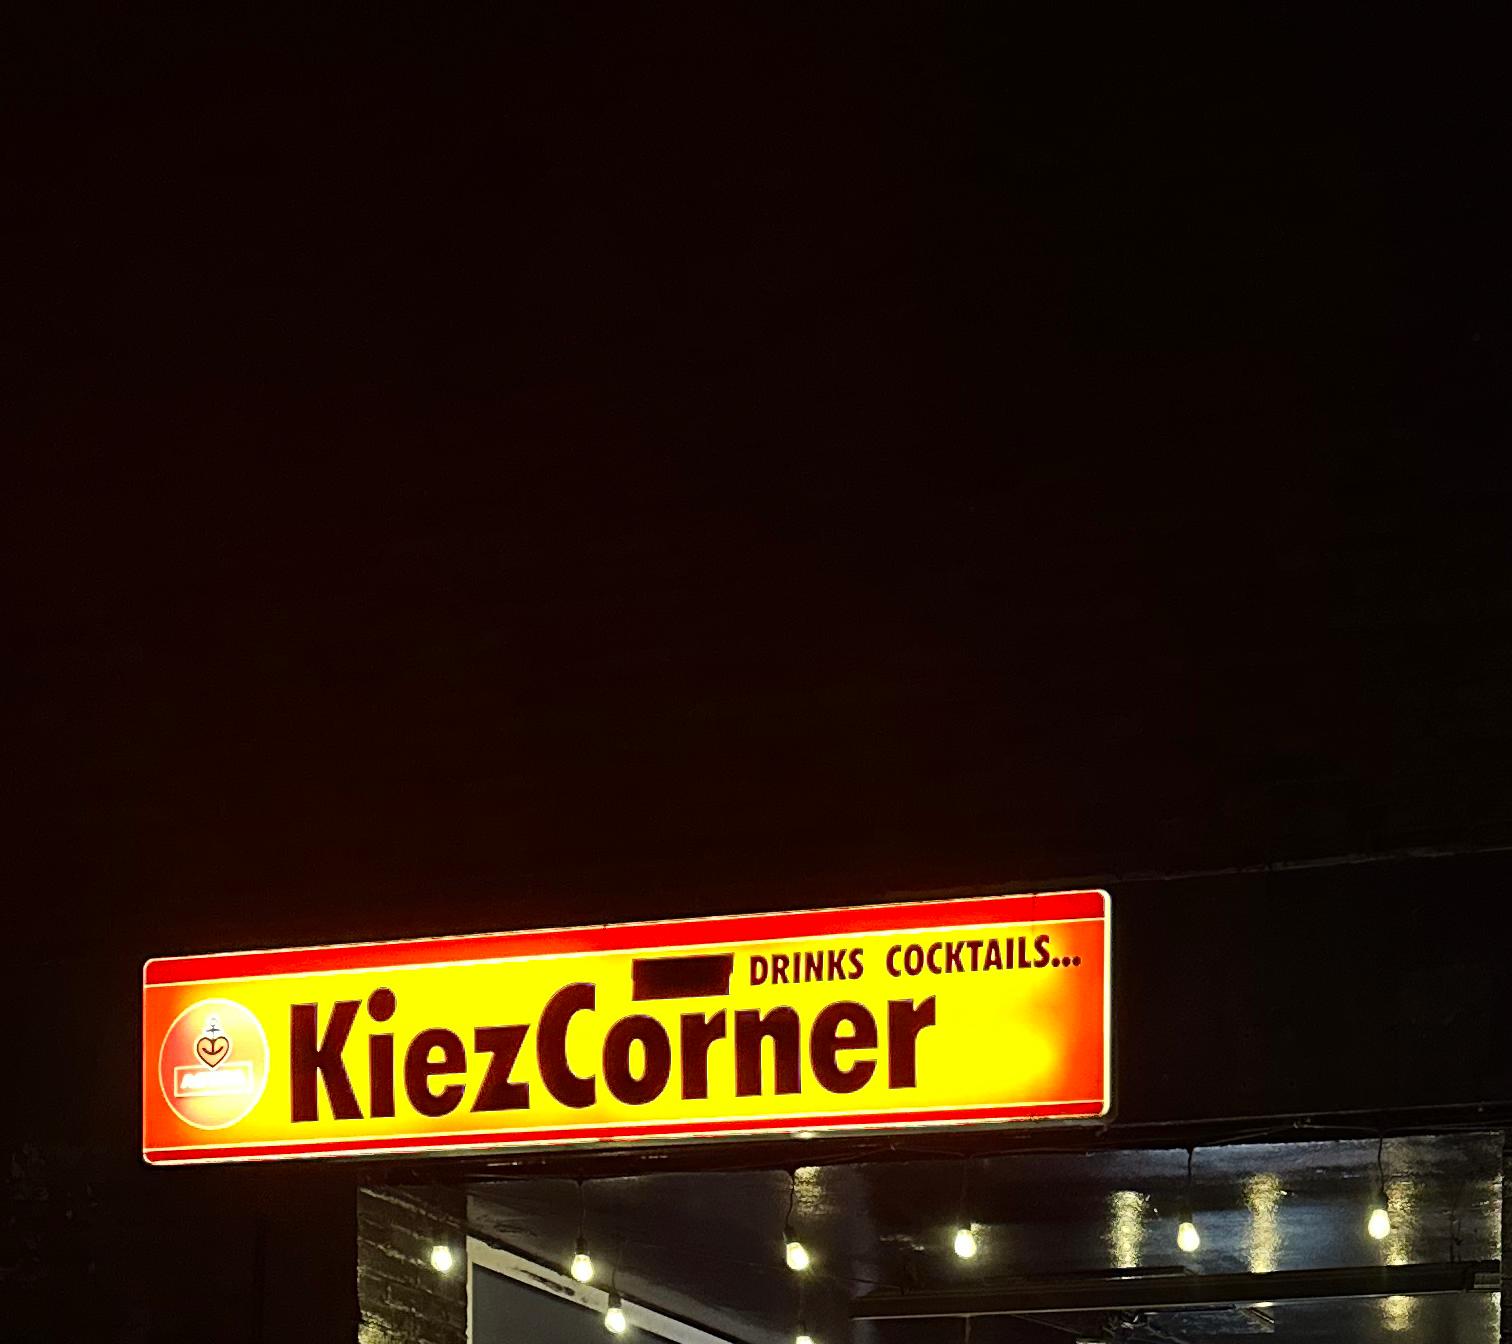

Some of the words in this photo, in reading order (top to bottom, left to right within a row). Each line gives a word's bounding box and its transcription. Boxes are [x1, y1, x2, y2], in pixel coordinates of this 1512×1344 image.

[750, 947, 864, 987] DRINKS
[886, 934, 1082, 977] COCKTAILS...
[290, 982, 936, 1123] KiezCorner
